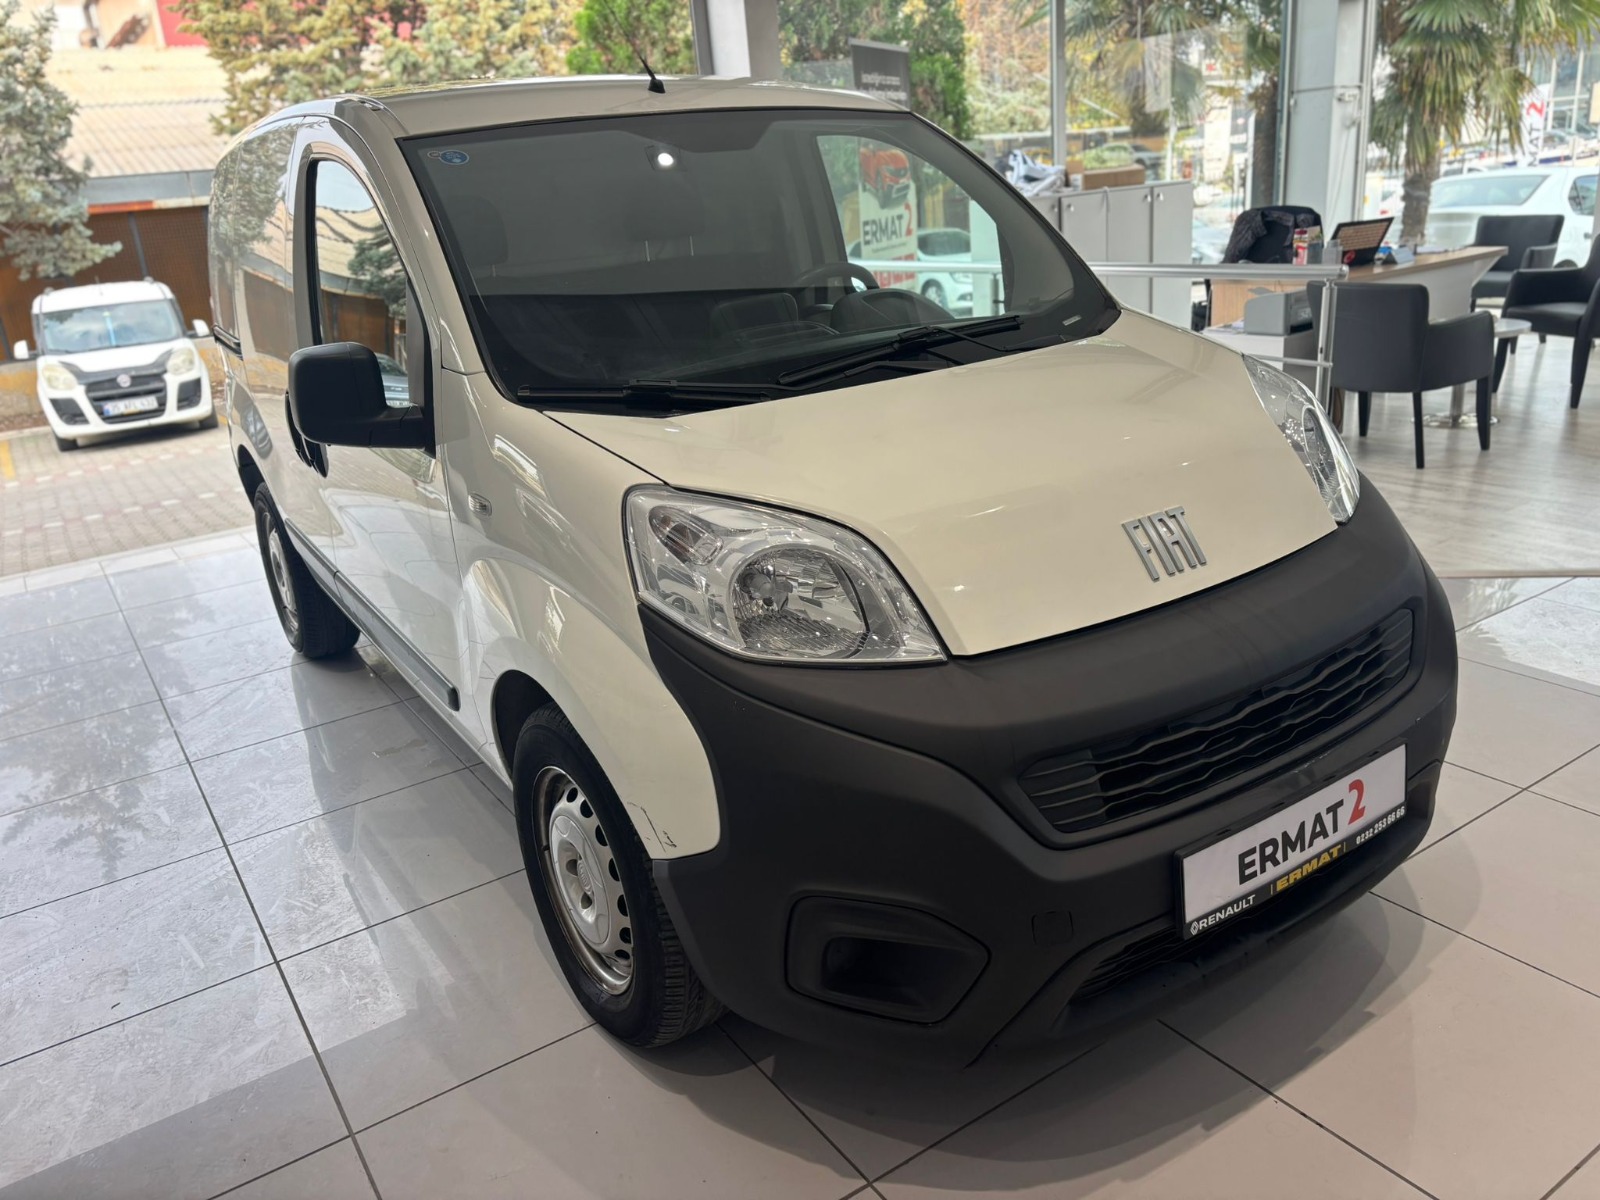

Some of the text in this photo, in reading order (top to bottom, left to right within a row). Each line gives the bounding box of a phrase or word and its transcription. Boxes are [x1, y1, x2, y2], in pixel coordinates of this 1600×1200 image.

[862, 202, 914, 246] ERMAT 2
[1121, 506, 1207, 583] FIAT
[1238, 779, 1366, 886] ERMAT 2
[1356, 806, 1405, 845] 0232 253 66 66
[1276, 844, 1342, 892] ERMAT
[1199, 894, 1256, 930] RENAULT
